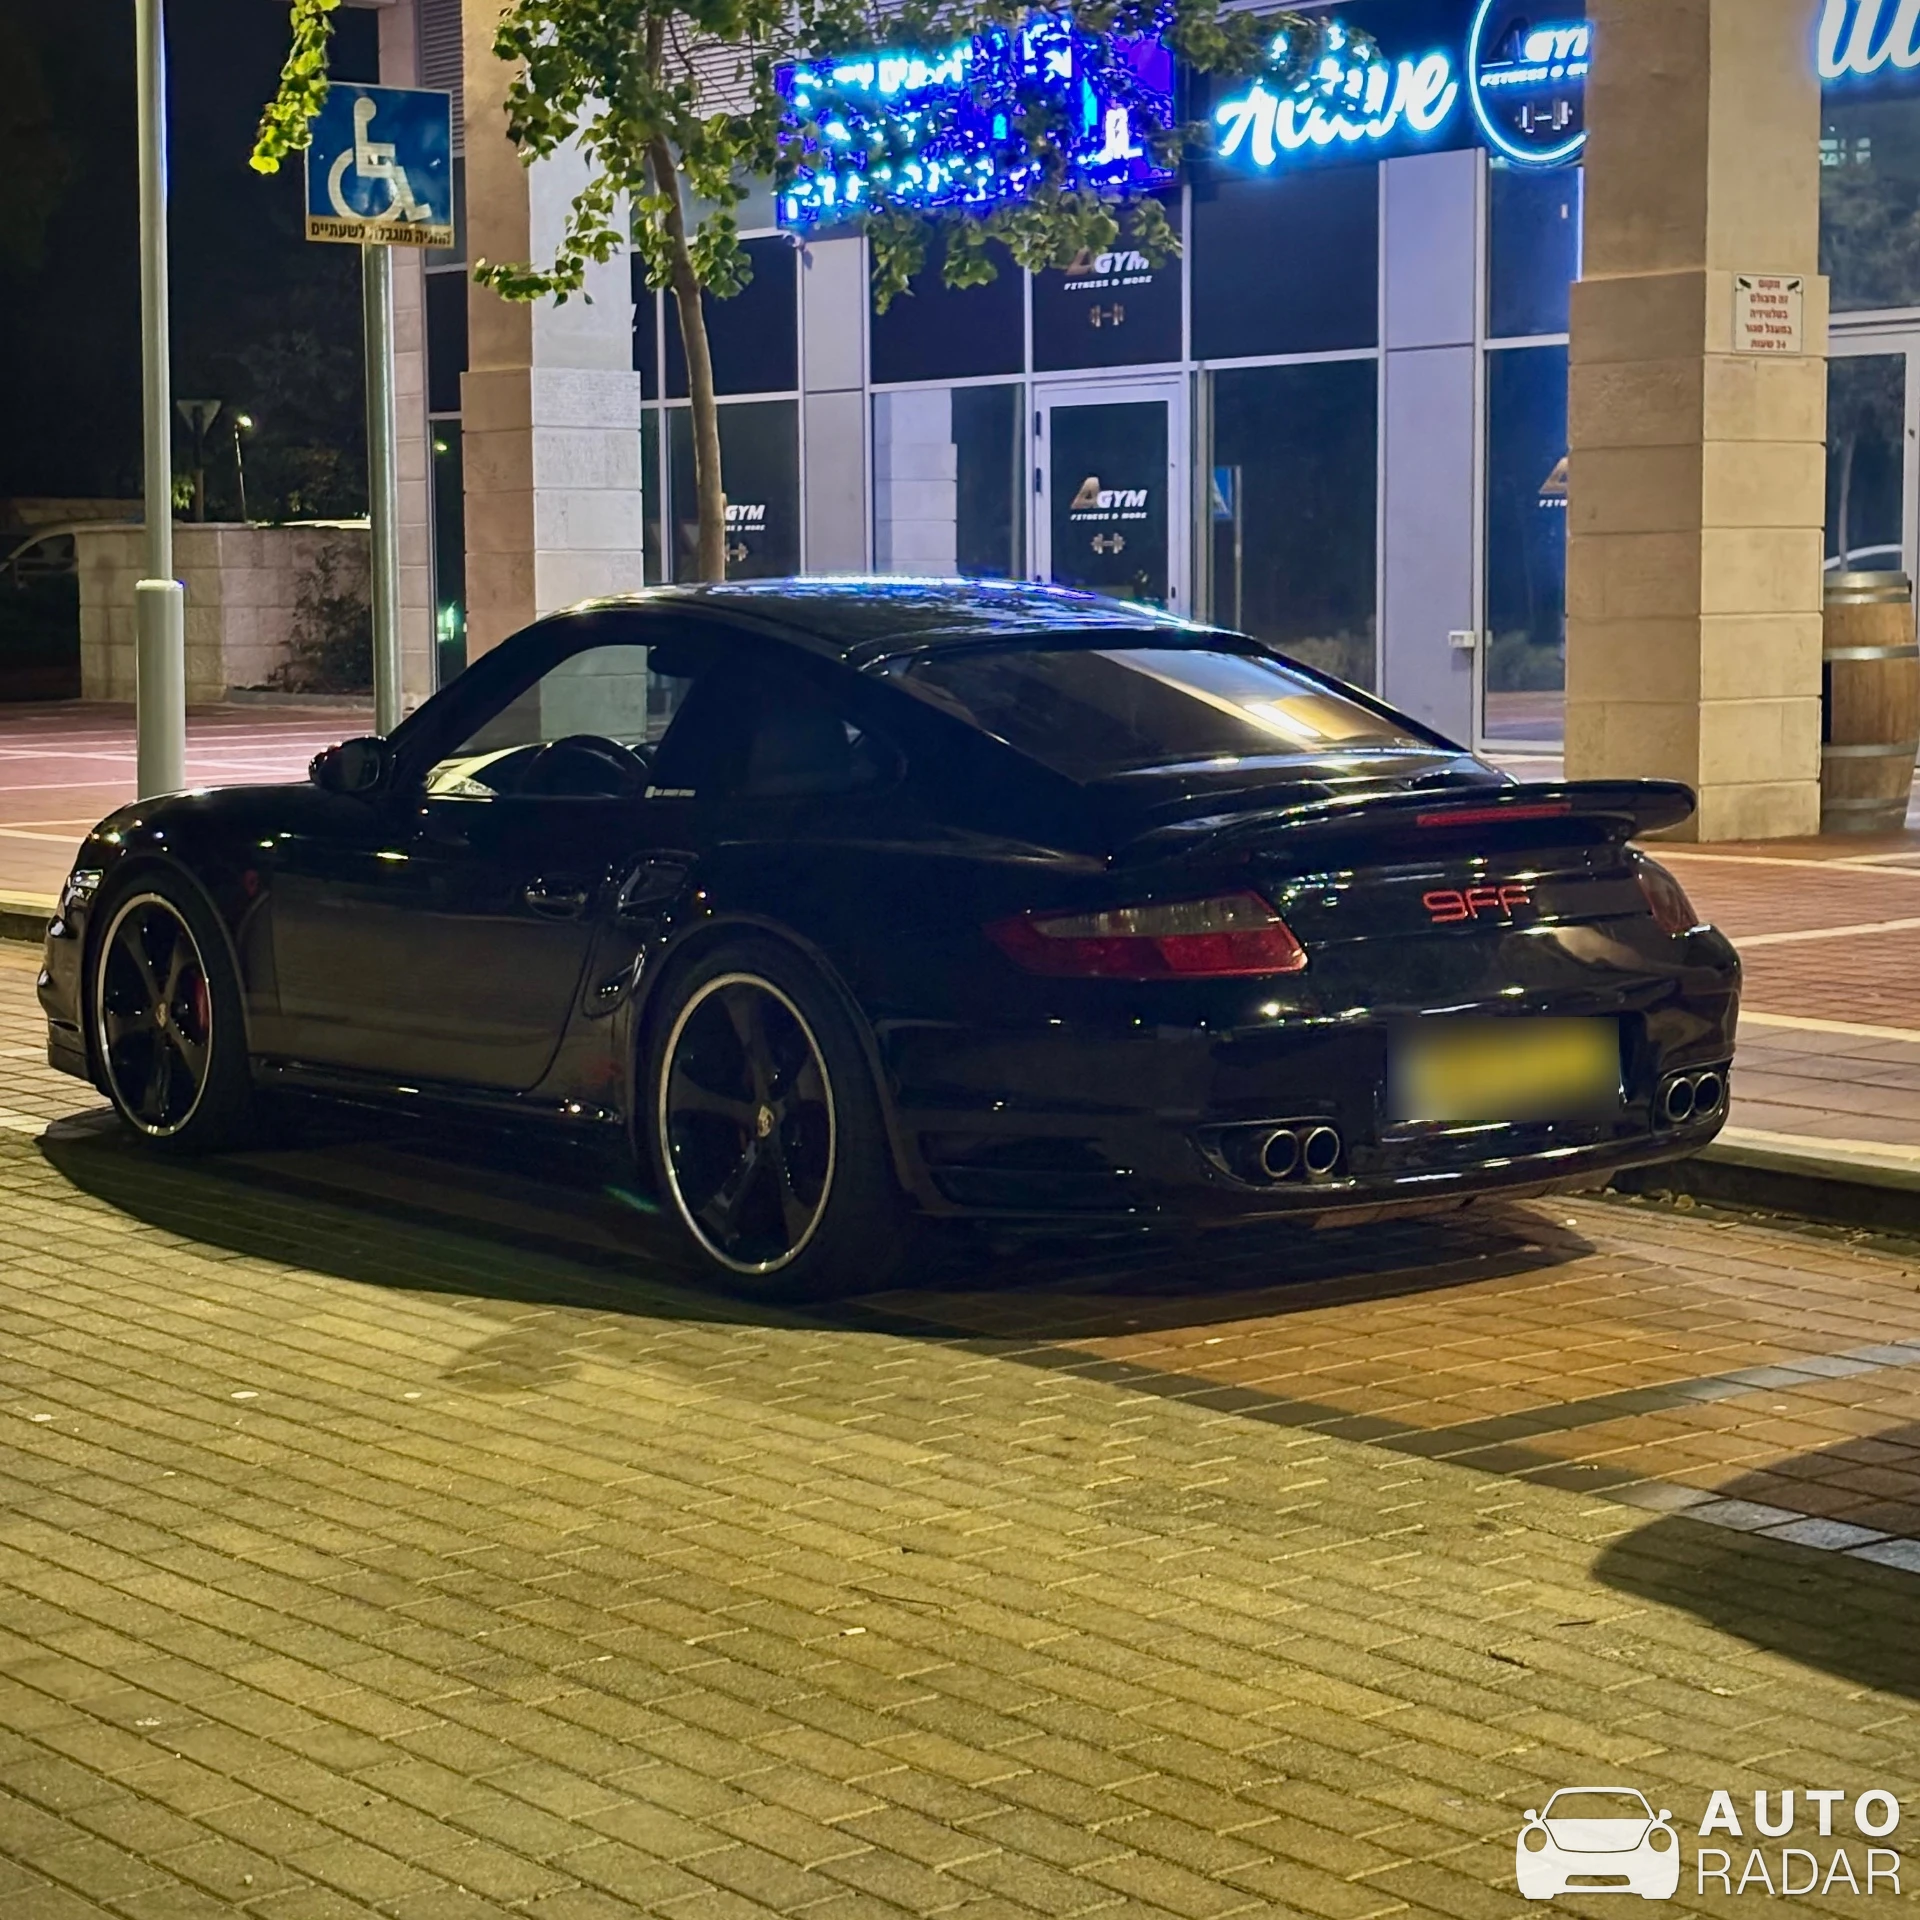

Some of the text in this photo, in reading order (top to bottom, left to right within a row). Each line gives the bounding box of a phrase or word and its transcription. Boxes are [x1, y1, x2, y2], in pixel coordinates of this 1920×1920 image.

[311, 222, 365, 239] לשעתיים
[1064, 279, 1109, 290] FITNESS
[1122, 275, 1153, 285] MORE
[1765, 321, 1792, 335] במעגל
[1750, 339, 1774, 349] שעות
[1070, 513, 1110, 521] FITNESS
[1423, 885, 1531, 923] 9FF
